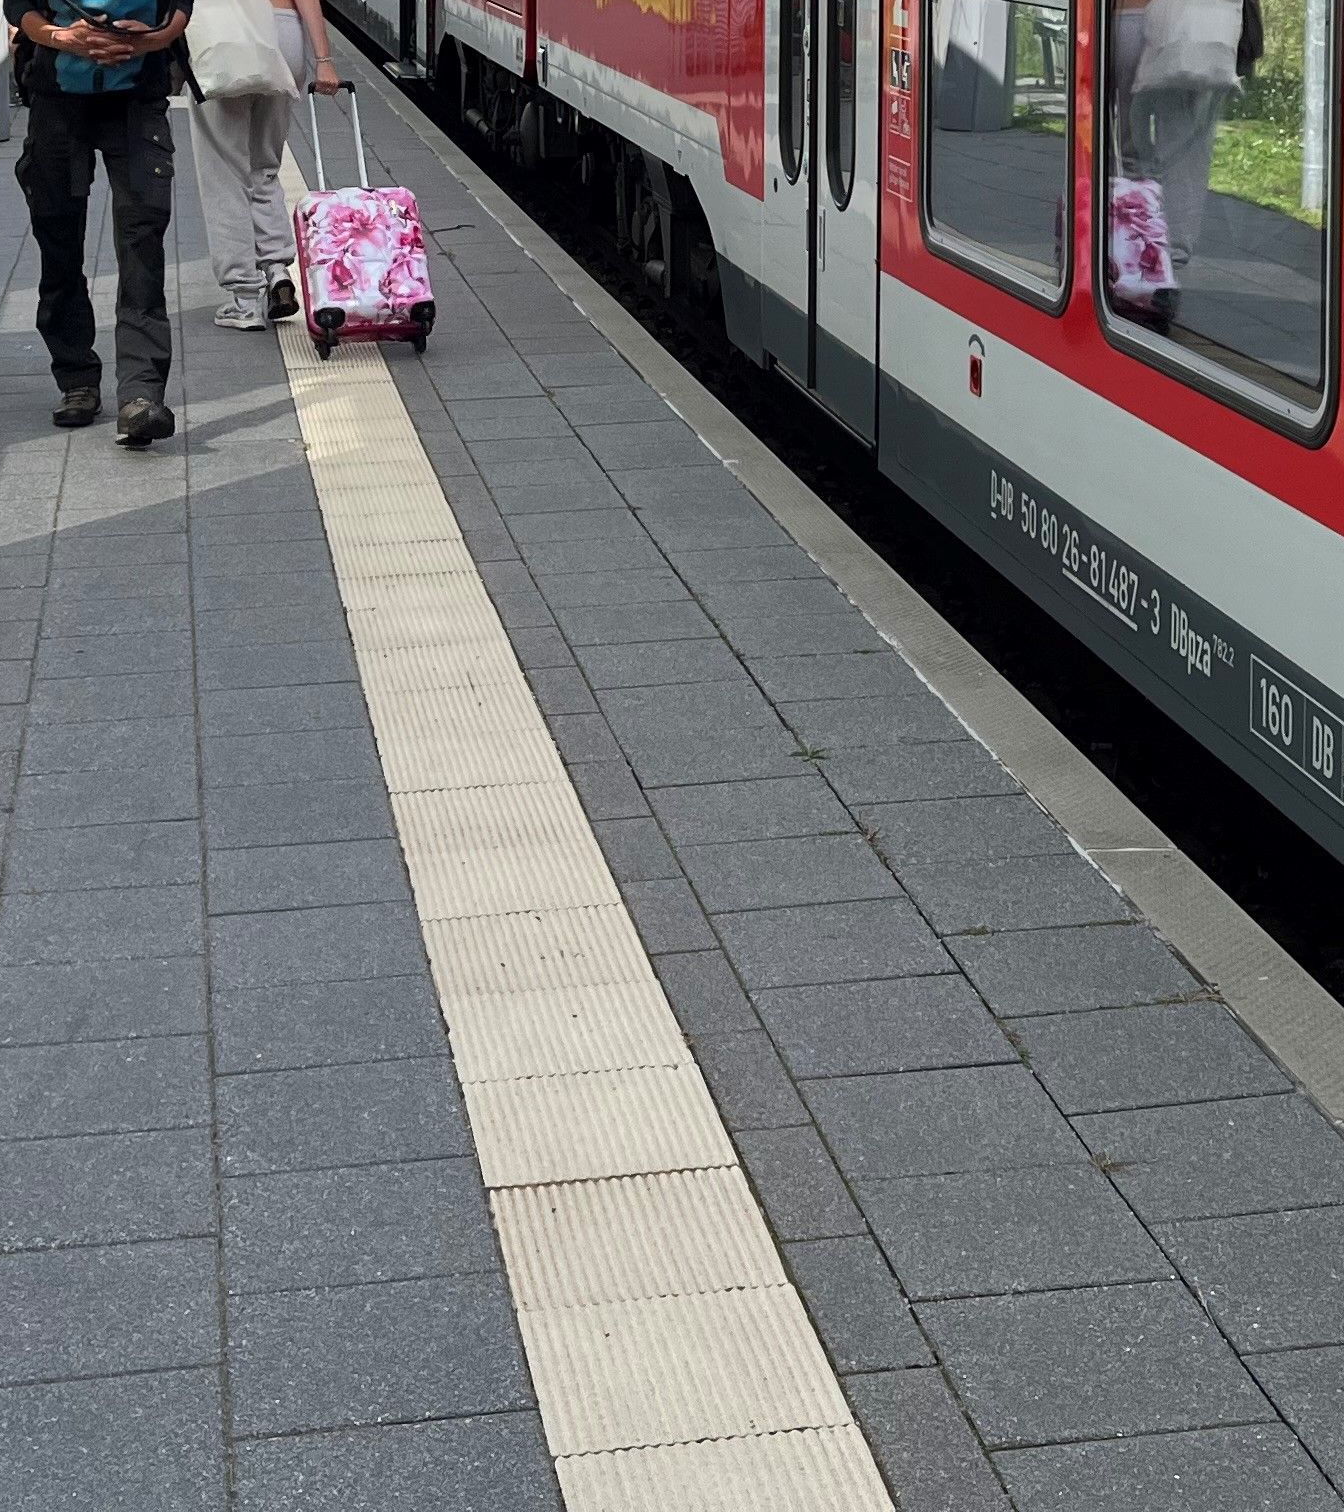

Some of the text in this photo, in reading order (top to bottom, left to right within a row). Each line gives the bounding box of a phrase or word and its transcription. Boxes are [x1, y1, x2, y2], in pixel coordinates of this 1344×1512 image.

[990, 469, 1014, 521] D-DB
[1021, 491, 1037, 539] 50
[1041, 508, 1058, 555] 80
[1260, 678, 1293, 746] 160
[1312, 715, 1335, 779] DB
